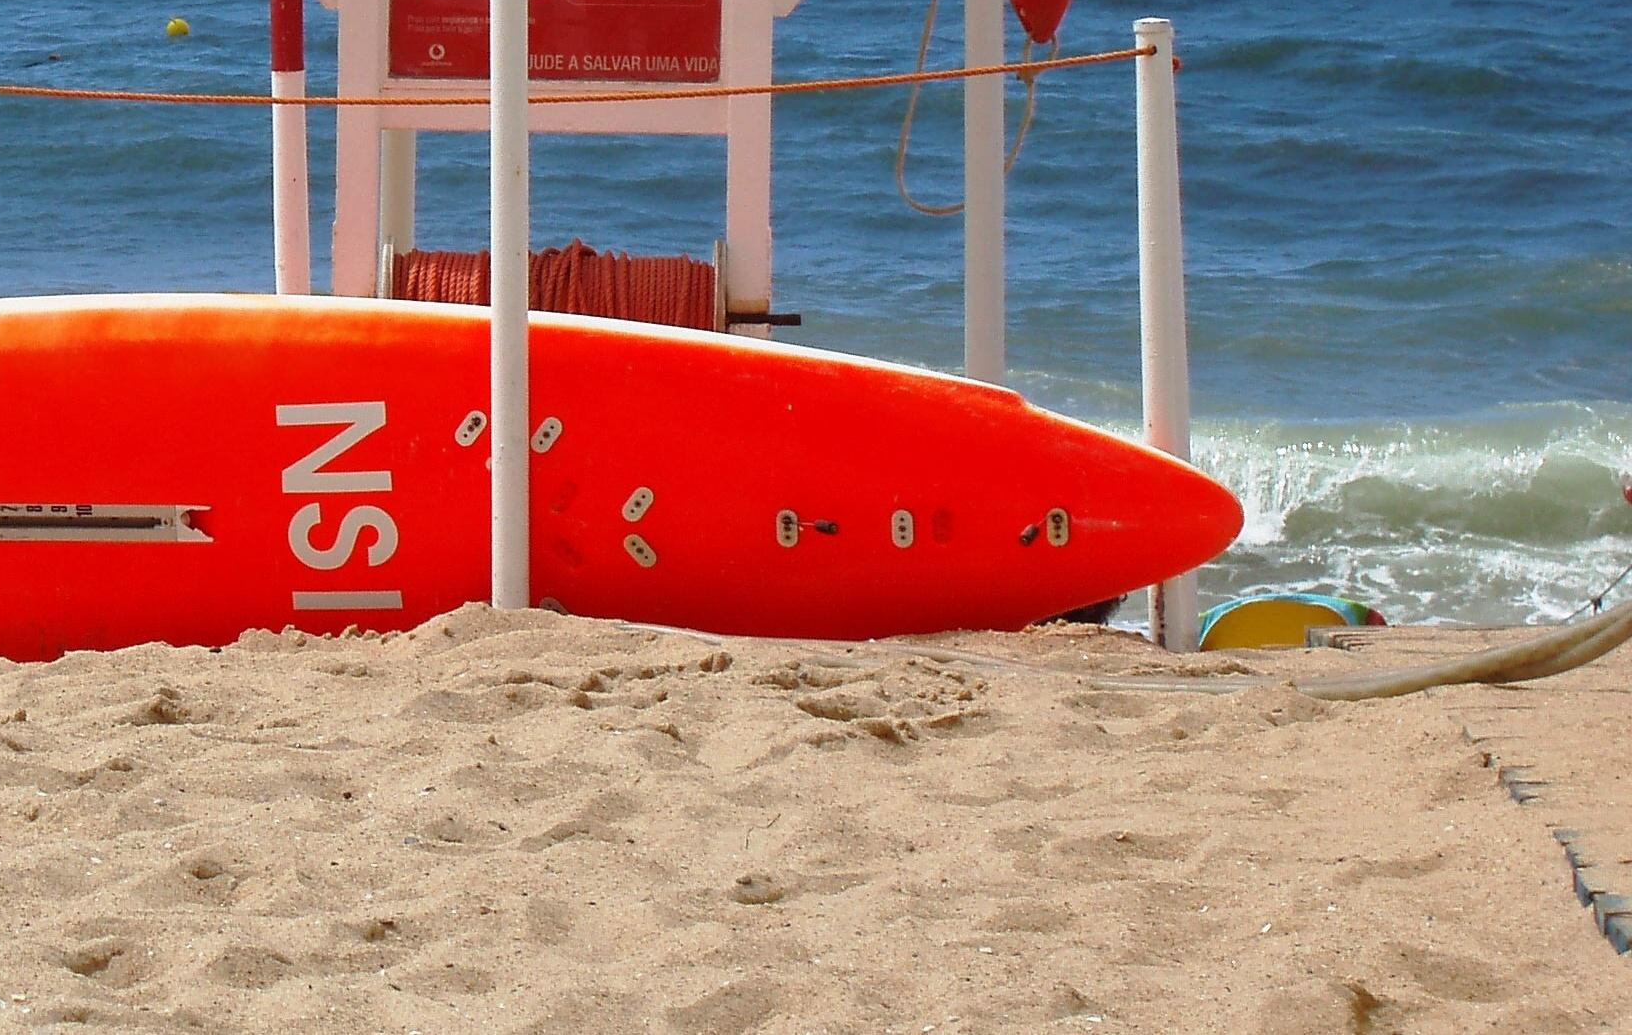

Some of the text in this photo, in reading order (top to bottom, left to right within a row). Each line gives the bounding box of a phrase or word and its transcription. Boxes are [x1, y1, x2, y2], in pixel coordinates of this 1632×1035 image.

[527, 54, 719, 73] JUDE A SALVAR UMA VIDA
[76, 505, 92, 517] 10
[275, 401, 404, 611] ISN
